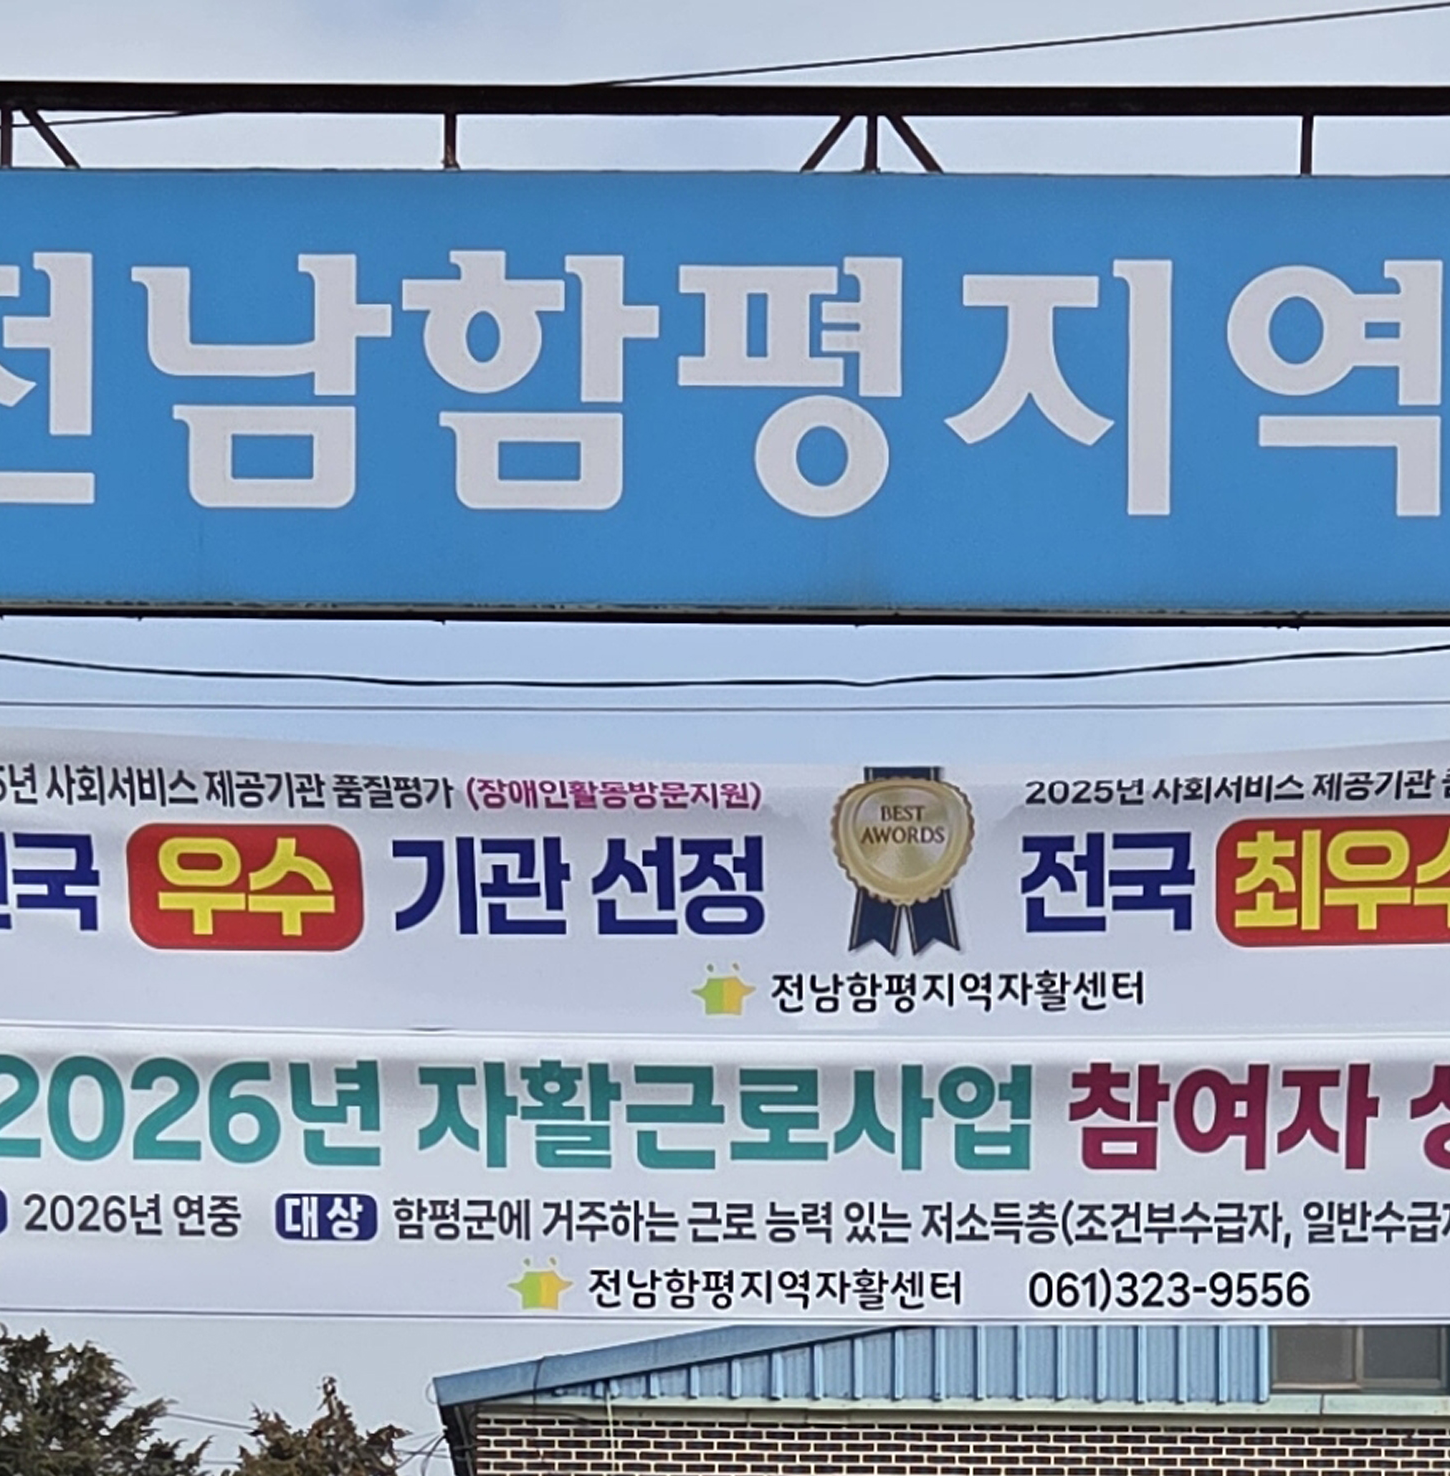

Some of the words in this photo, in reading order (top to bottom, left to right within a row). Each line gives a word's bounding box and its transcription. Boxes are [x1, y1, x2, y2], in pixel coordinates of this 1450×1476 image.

[45, 765, 199, 806] 사회서비스
[205, 769, 326, 808] 제공기관
[332, 773, 453, 809] 품질평가
[466, 776, 762, 812] (장애인활동방문지원)
[1025, 777, 1144, 806] 2025년
[1152, 773, 1305, 805] 사회서비스
[1312, 768, 1437, 802] 제공기관
[861, 826, 945, 845] AWORDS
[881, 805, 925, 822] BEST
[156, 836, 337, 937] 우수
[391, 837, 570, 936] 기관
[591, 835, 766, 937] 선정
[1019, 831, 1196, 934] 전국
[771, 970, 1145, 1012] 전남함평지역자활센터
[417, 1060, 1033, 1172] 자활근로사업
[1068, 1062, 1379, 1171] 참여자
[24, 1194, 162, 1235] 2026년
[173, 1195, 241, 1237] 연중
[285, 1196, 362, 1238] 대상
[393, 1197, 531, 1242] 함평군에
[542, 1200, 679, 1243] 거주하는
[687, 1201, 757, 1243] 근로
[765, 1201, 833, 1244] 능력
[843, 1201, 912, 1244] 있는
[588, 1267, 962, 1310] 전남함평지역자활센터
[1028, 1268, 1311, 1312] 061)323-9556
